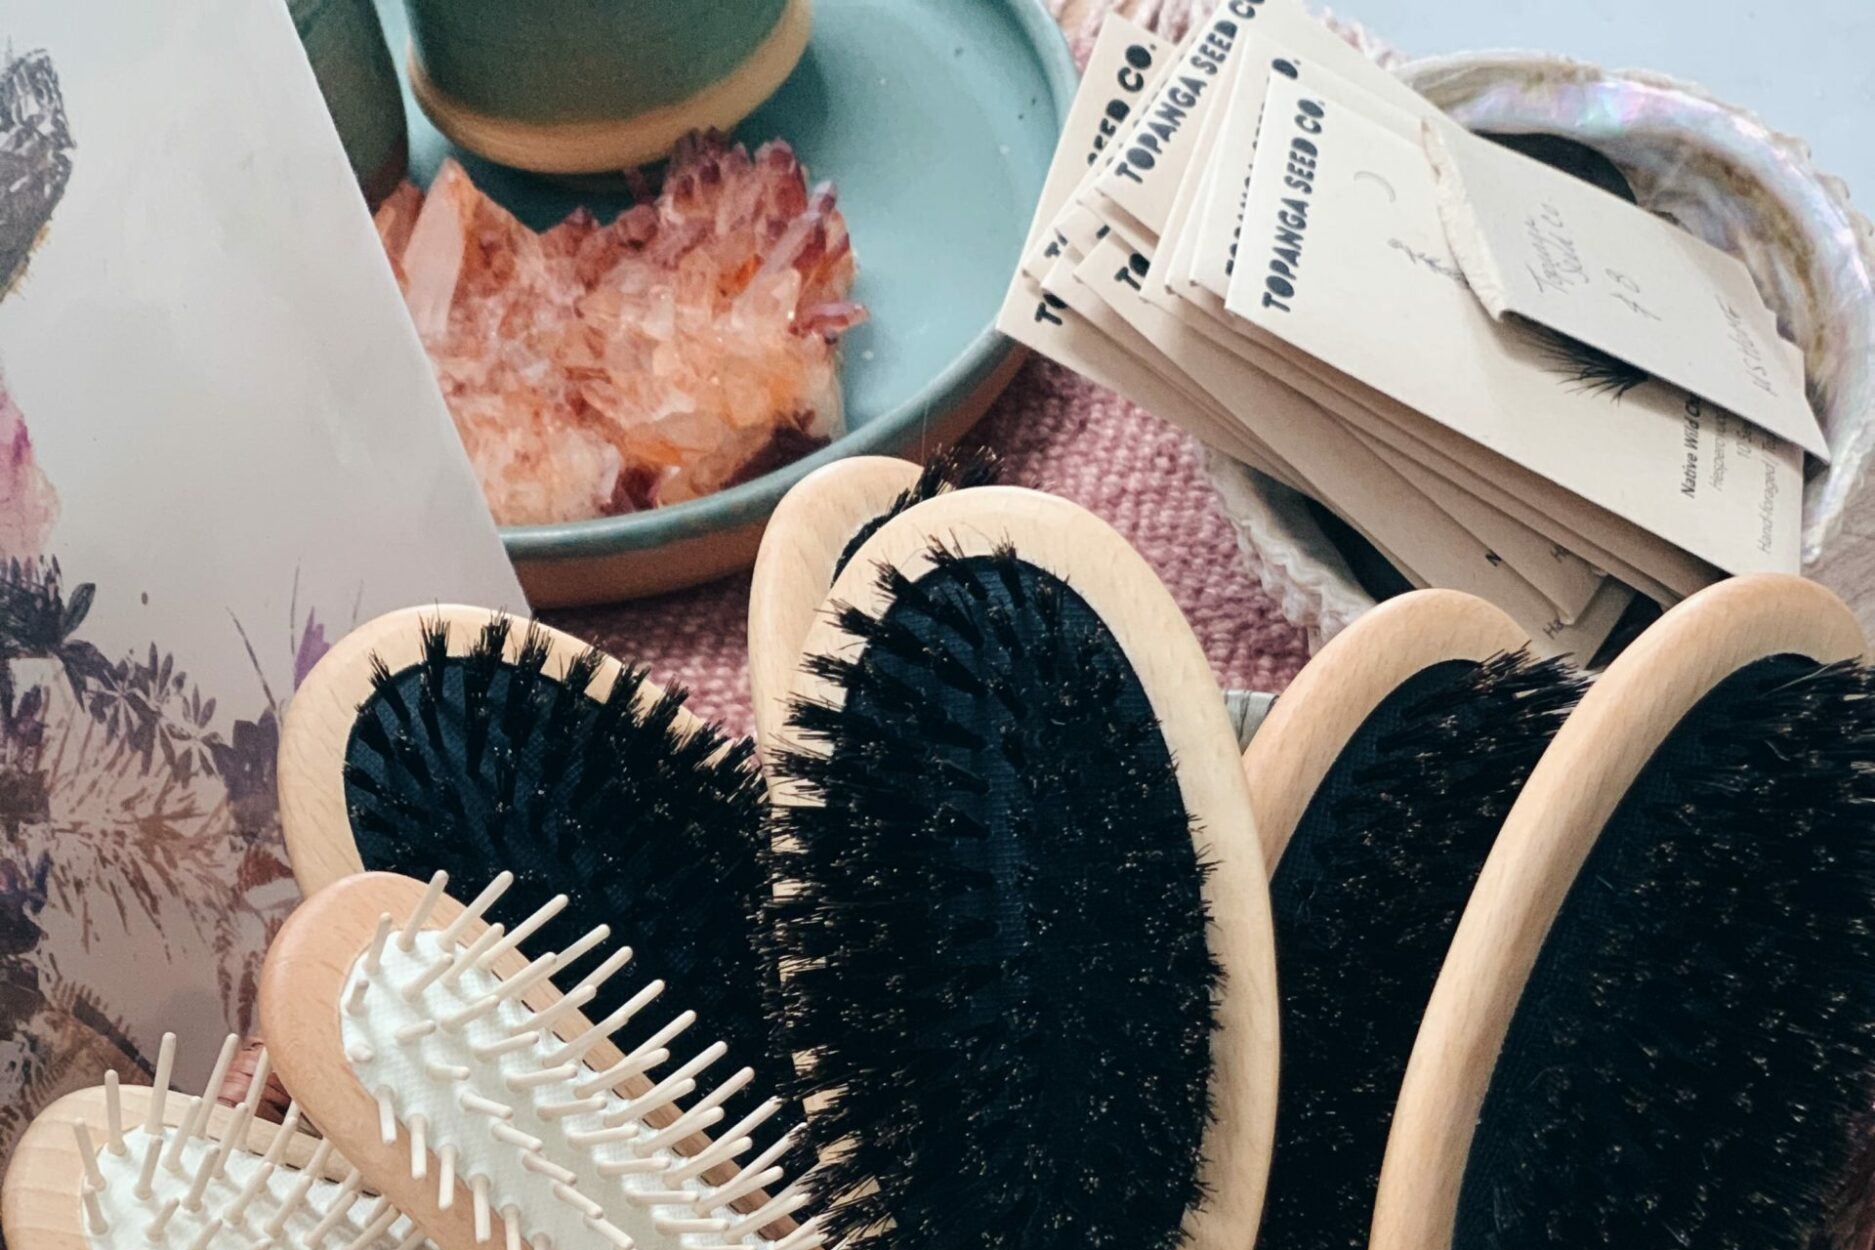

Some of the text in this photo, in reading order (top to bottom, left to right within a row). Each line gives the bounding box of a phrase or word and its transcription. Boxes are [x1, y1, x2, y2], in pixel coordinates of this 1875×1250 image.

[1114, 76, 1207, 184] TOPANGA
[1190, 20, 1238, 75] SEED
[1228, 0, 1265, 19] C
[1117, 44, 1157, 93] CO.
[1262, 98, 1326, 313] TOPANGA SEED CO.
[1684, 415, 1700, 450] Wild
[1681, 452, 1698, 499] Native
